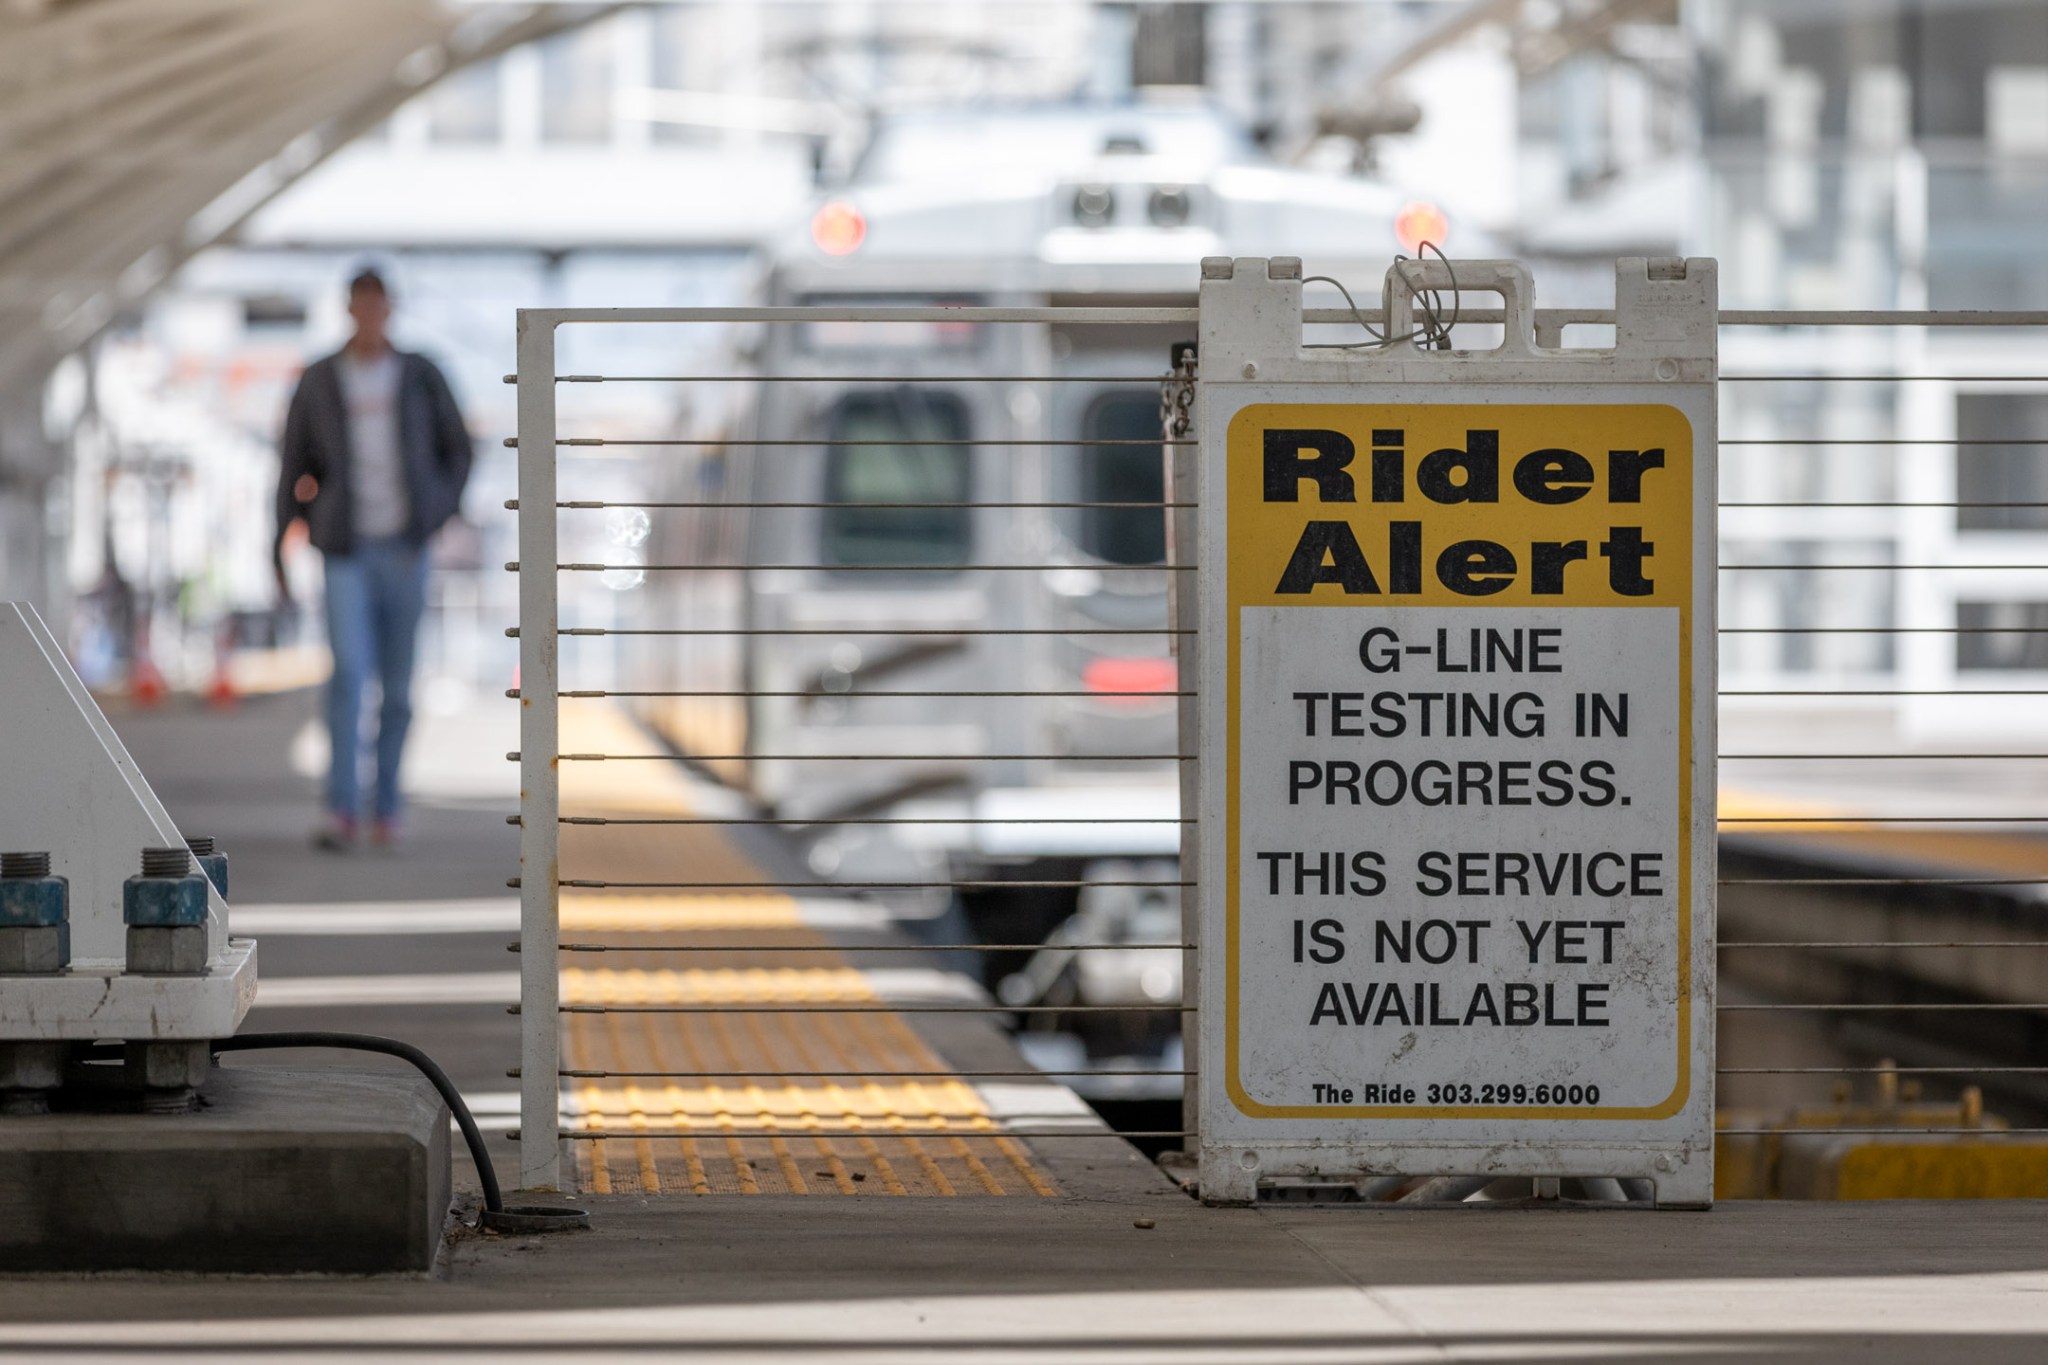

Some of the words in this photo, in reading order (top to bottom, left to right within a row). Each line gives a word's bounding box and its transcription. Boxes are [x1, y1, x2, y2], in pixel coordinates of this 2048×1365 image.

[1263, 429, 1666, 505] Rider
[1274, 521, 1655, 597] Alert
[1359, 627, 1563, 673] G-LINE
[1293, 692, 1545, 738] TESTING
[1576, 693, 1628, 737] IN
[1289, 760, 1631, 806] PROGRESS.
[1257, 851, 1387, 897] THIS
[1416, 851, 1663, 897] SERVICE
[1293, 919, 1345, 965] IS
[1376, 920, 1490, 965] NOT
[1516, 921, 1625, 965] YET
[1309, 983, 1610, 1027] AVAILABLE
[1312, 1084, 1354, 1104] The
[1365, 1084, 1416, 1104] Ride
[1427, 1084, 1600, 1105] 303.299.6000
